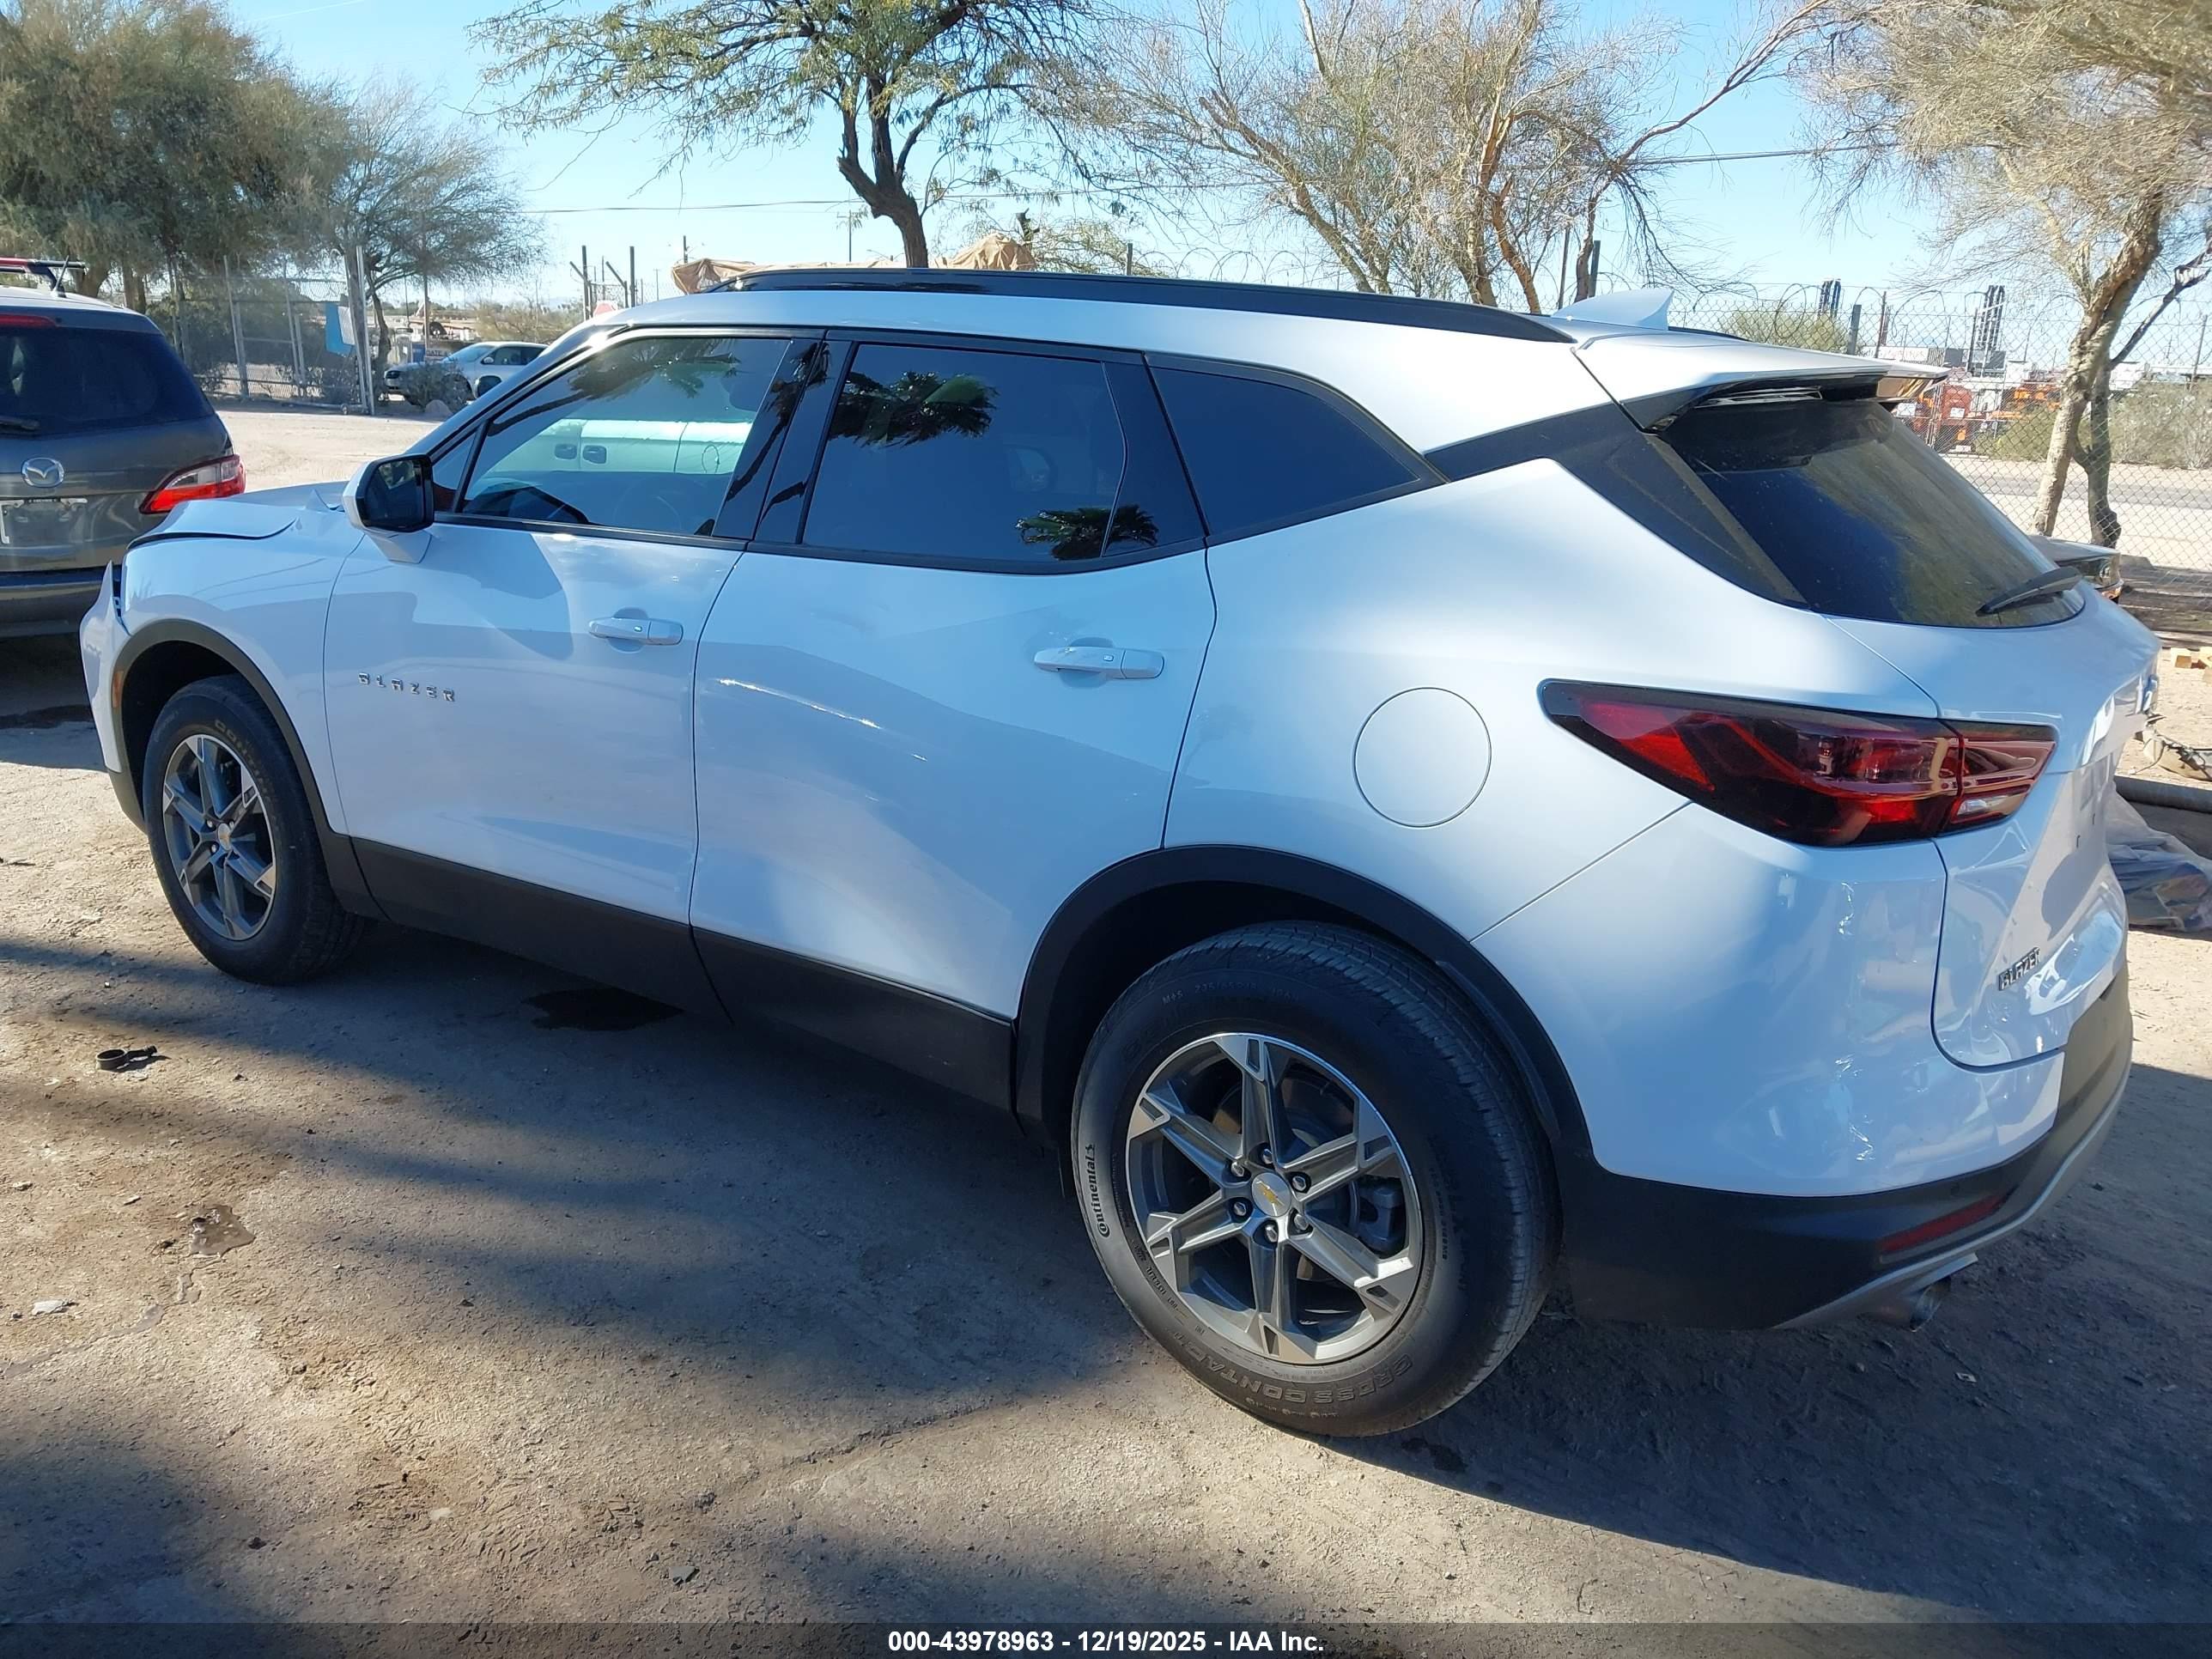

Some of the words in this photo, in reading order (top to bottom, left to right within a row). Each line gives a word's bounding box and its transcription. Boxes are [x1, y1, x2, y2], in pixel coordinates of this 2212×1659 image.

[358, 672, 455, 702] BLAZER
[1999, 947, 2041, 991] BLAZER
[1085, 1154, 1110, 1237] Continental
